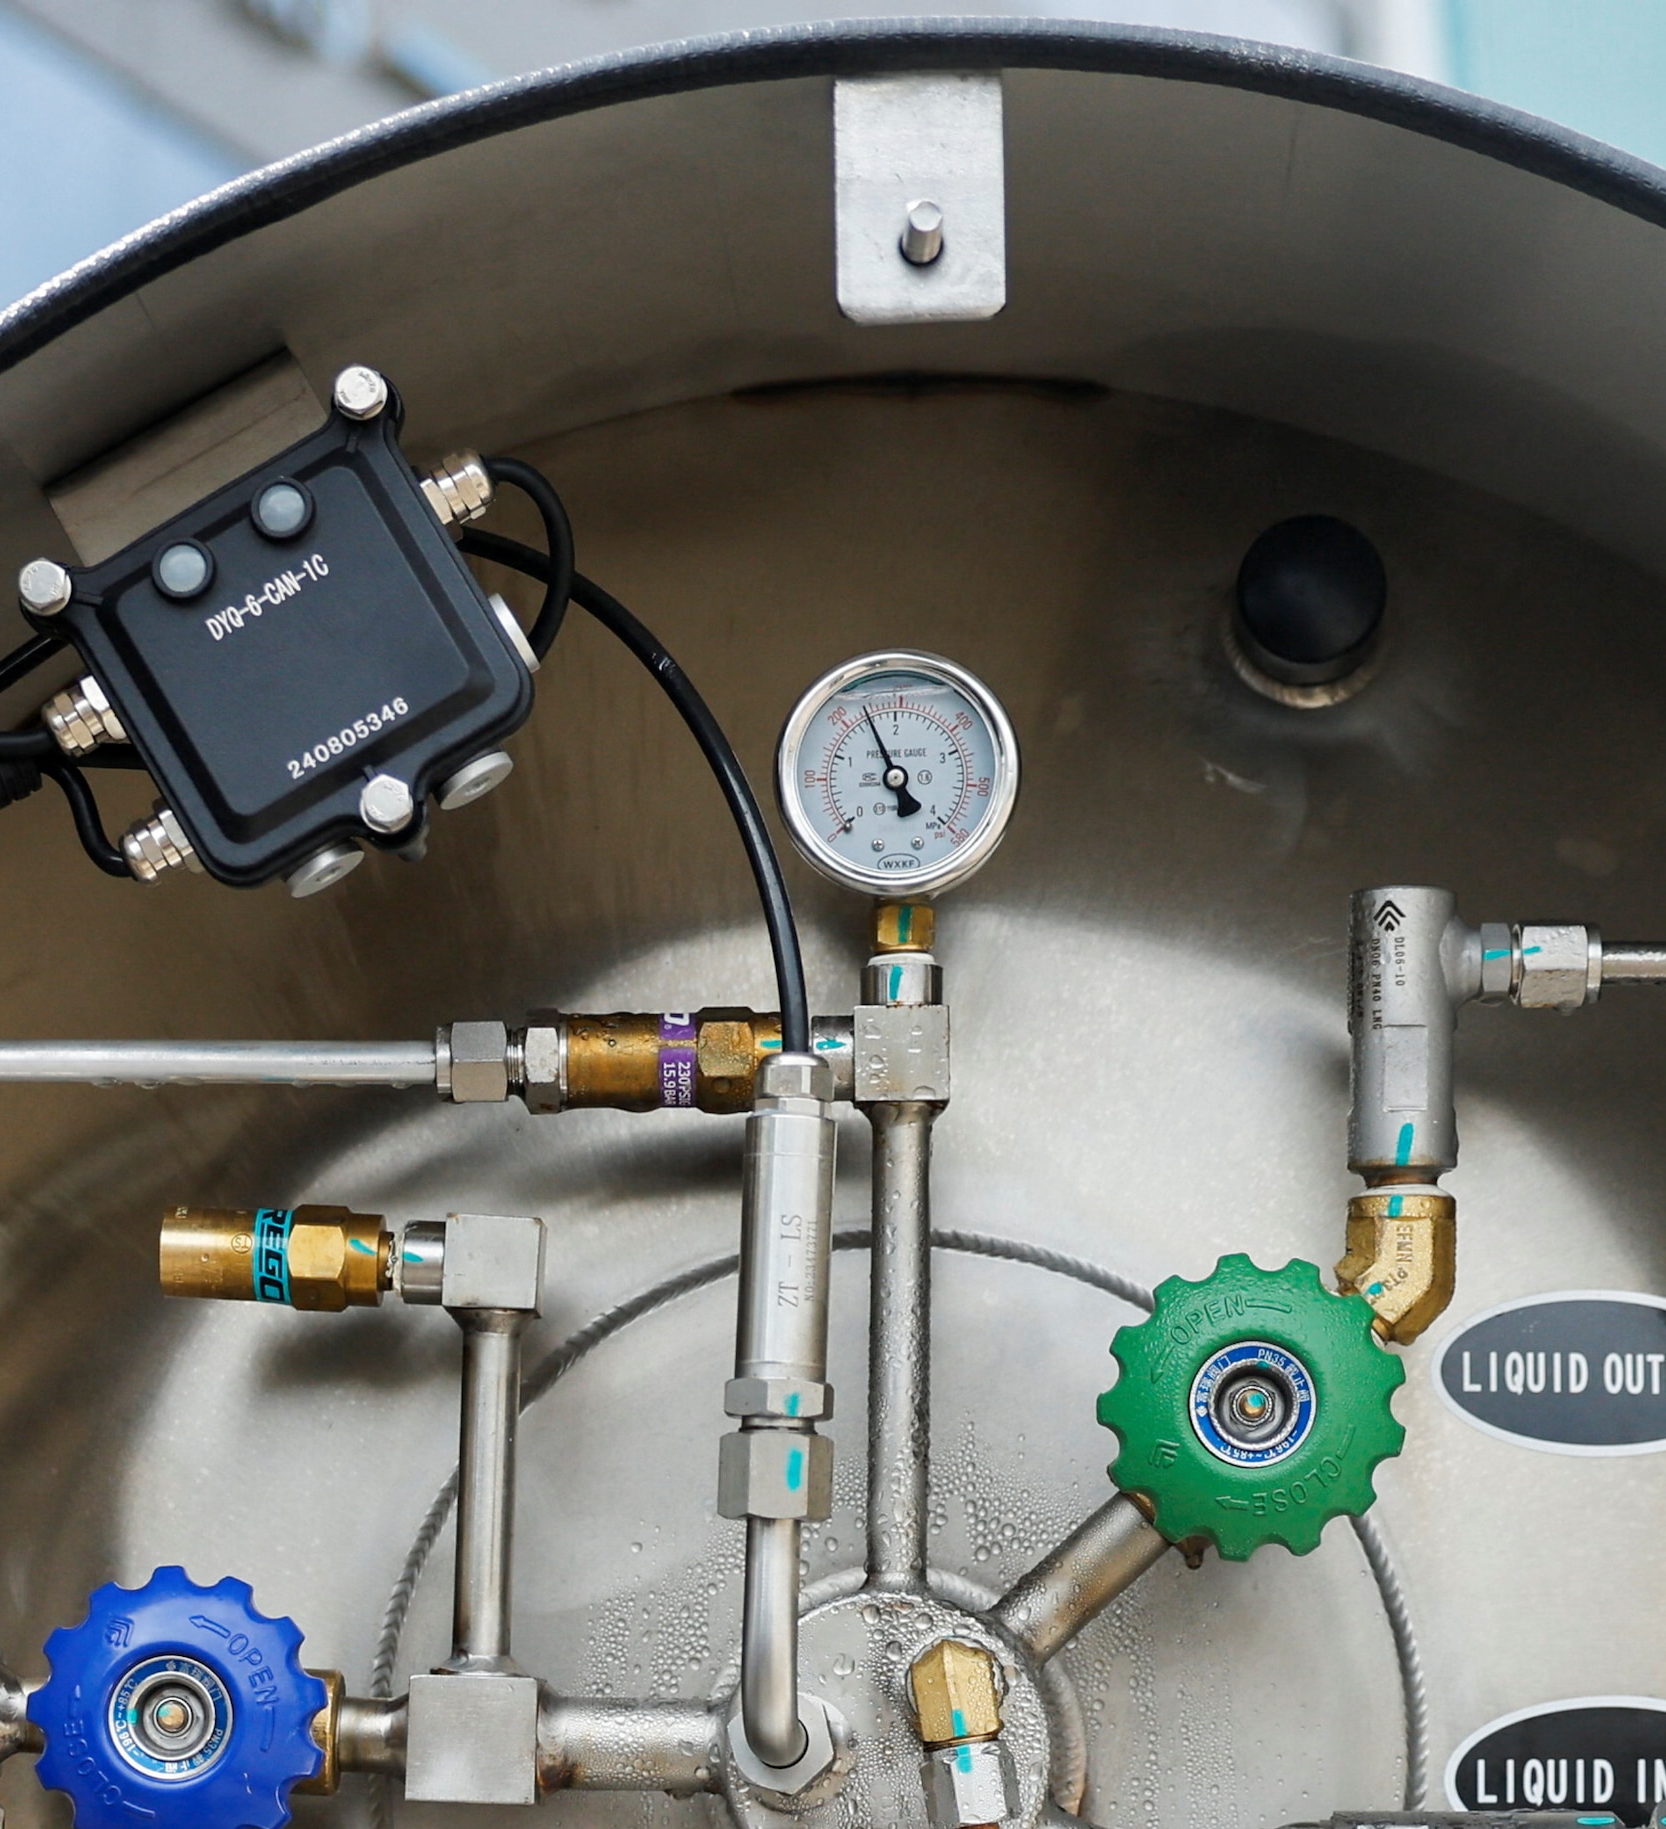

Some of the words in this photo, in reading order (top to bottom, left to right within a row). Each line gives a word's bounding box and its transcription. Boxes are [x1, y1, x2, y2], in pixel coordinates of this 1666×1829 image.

[205, 554, 330, 641] DYQ-6-CAN-1C
[828, 707, 847, 726] 200
[955, 711, 973, 730] 400
[287, 697, 410, 779] 240805346
[893, 725, 899, 736] 2
[866, 749, 901, 759] PRESURE
[904, 748, 927, 758] GAUGE
[940, 753, 946, 764] 3
[804, 770, 815, 789] 100
[977, 777, 989, 797] 500
[857, 806, 863, 817] 0
[930, 805, 936, 816] 4
[951, 829, 969, 848] 580
[883, 859, 915, 869] WXKF
[1394, 937, 1406, 986] DL06-10
[1372, 973, 1382, 1002] PN40
[1372, 1009, 1383, 1030] LNG
[259, 1209, 287, 1302] REGO
[1170, 1294, 1246, 1345] OPEN
[1258, 1348, 1287, 1367] PN35
[1461, 1350, 1589, 1397] LIQUID
[1252, 1458, 1339, 1517] CLOSE
[228, 1633, 280, 1706] OPEN
[63, 1719, 123, 1806] CLOSE
[1475, 1757, 1615, 1808] LIQUID
